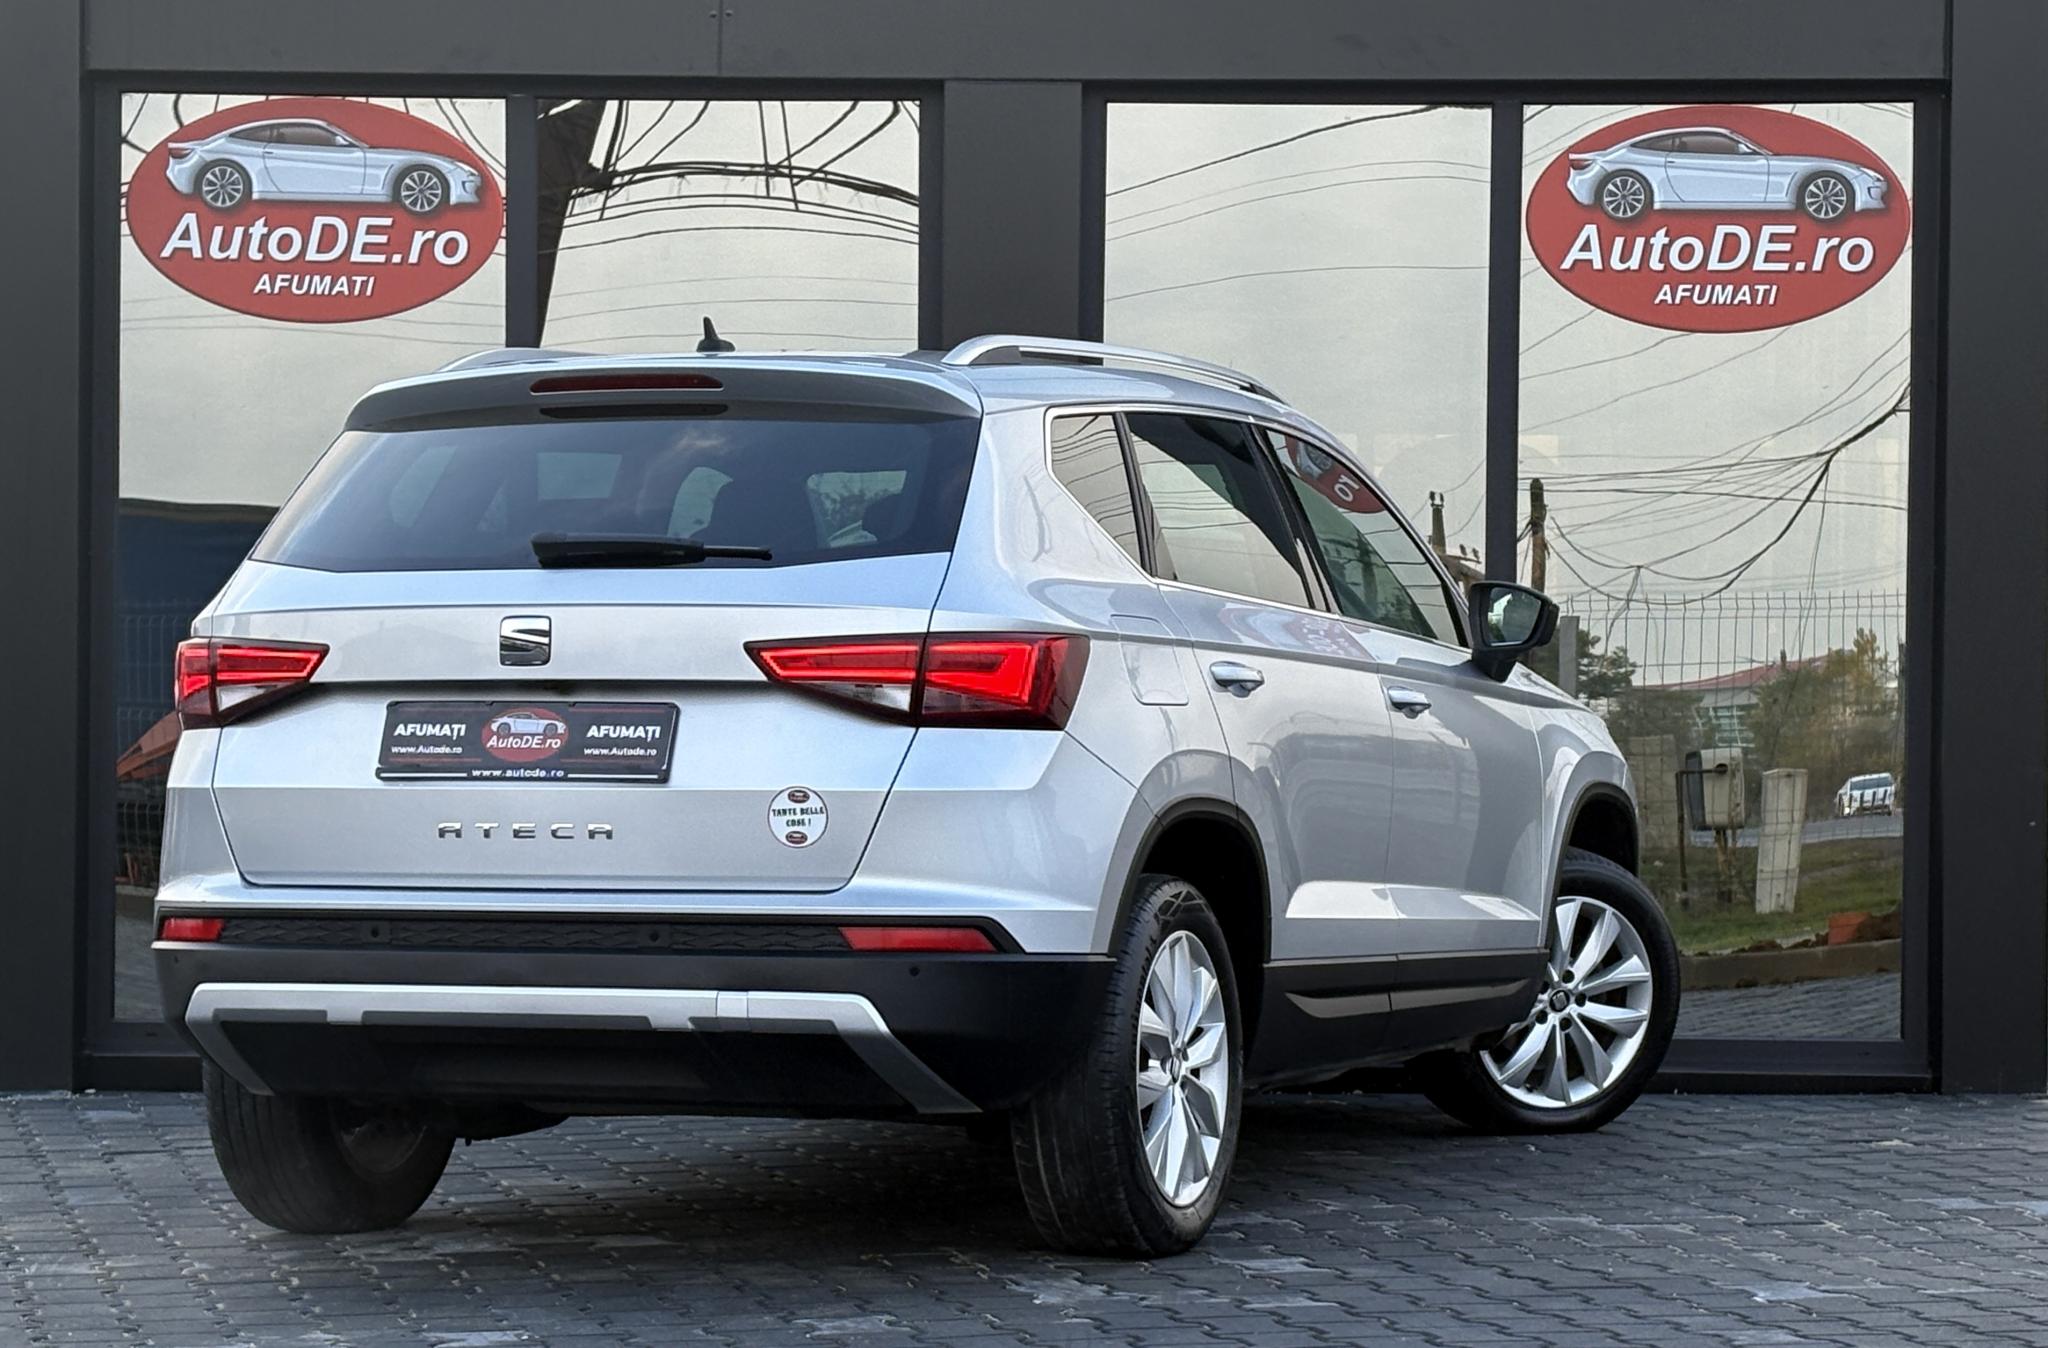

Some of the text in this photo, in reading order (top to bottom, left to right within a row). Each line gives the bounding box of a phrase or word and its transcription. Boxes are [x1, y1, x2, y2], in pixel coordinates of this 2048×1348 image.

[160, 213, 469, 265] AutoDE.ro
[1560, 224, 1874, 272] AutoDE.ro
[254, 274, 375, 296] AFUMATI
[1654, 284, 1777, 305] AFUMATI
[391, 746, 462, 754] www.Autode.ro
[486, 735, 561, 750] AutoDE.ro
[584, 747, 657, 756] www.Autode.ro
[472, 769, 564, 777] www.autode.ro
[772, 807, 824, 816] TANTE BELLE
[438, 823, 613, 840] ATECA
